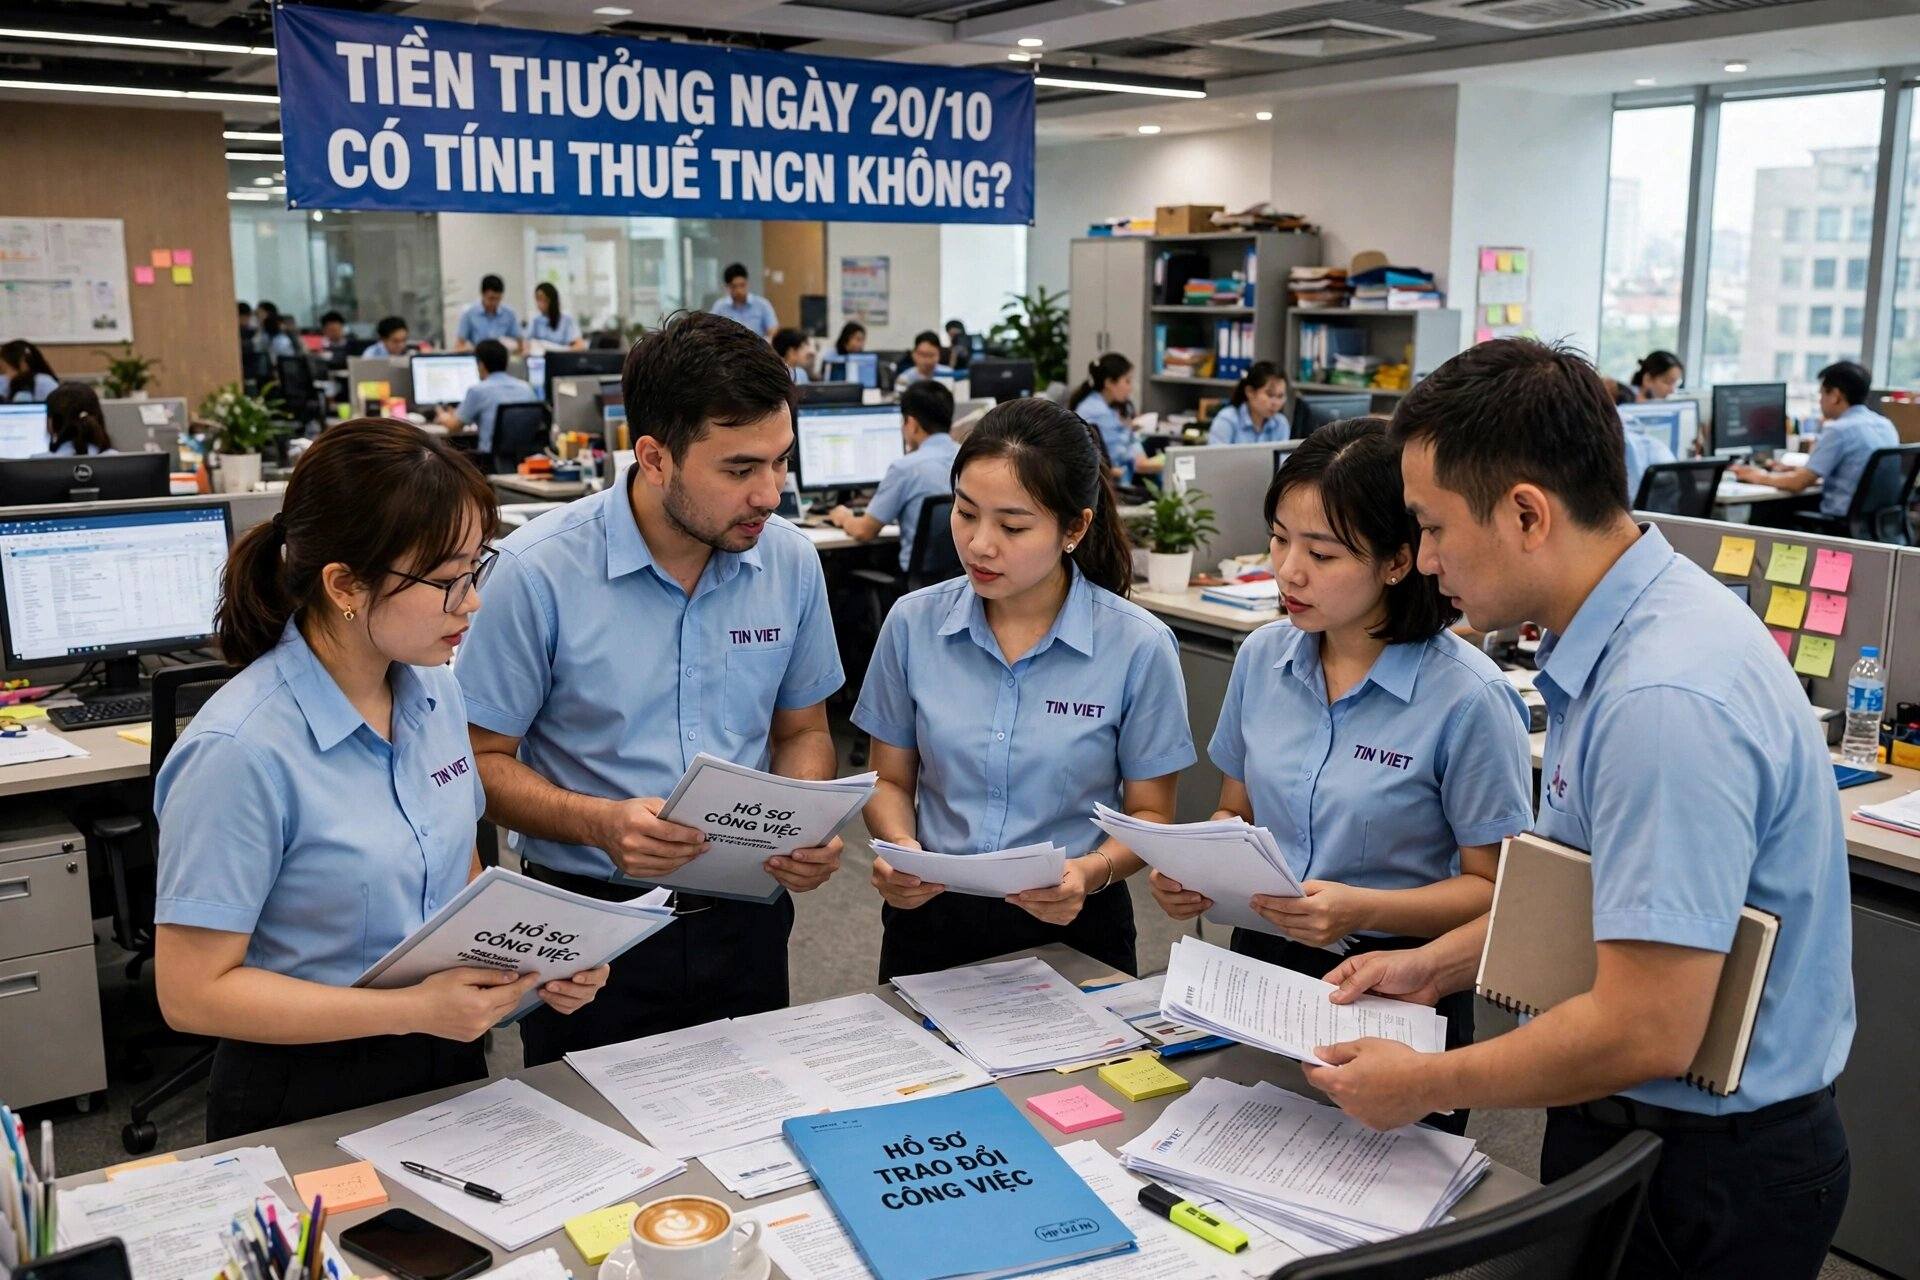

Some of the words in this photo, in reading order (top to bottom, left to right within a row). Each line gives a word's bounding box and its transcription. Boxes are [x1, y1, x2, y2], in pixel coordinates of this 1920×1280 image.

[335, 26, 475, 110] TIỀN
[490, 47, 715, 125] THƯỞNG
[730, 66, 858, 133] NGÀY
[871, 85, 992, 141] 20/10
[327, 117, 411, 191] CÓ
[423, 121, 555, 195] TÍNH
[567, 128, 701, 199] THUẾ
[711, 148, 835, 203] TNCN
[847, 146, 1012, 209] KHÔNG?
[729, 629, 751, 644] TIN
[754, 627, 781, 643] VIET
[1045, 700, 1068, 715] TIN
[1073, 702, 1105, 718] VIET
[430, 767, 452, 787] TIN
[448, 756, 470, 777] VIET
[1353, 744, 1377, 762] TIN
[1379, 749, 1414, 770] VIET
[704, 812, 758, 831] CÔNG
[763, 823, 802, 839] VIỆC
[764, 809, 796, 821] SƠ
[474, 931, 533, 953] CÔNG
[536, 945, 580, 963] VIỆC
[544, 931, 580, 945] SƠ
[882, 1134, 925, 1160] HỒ
[927, 1130, 967, 1152] SƠ
[873, 1159, 953, 1185] TRAO
[955, 1144, 1009, 1171] ĐỔI
[881, 1185, 966, 1210] CÔNG
[964, 1169, 1033, 1193] VIỆC
